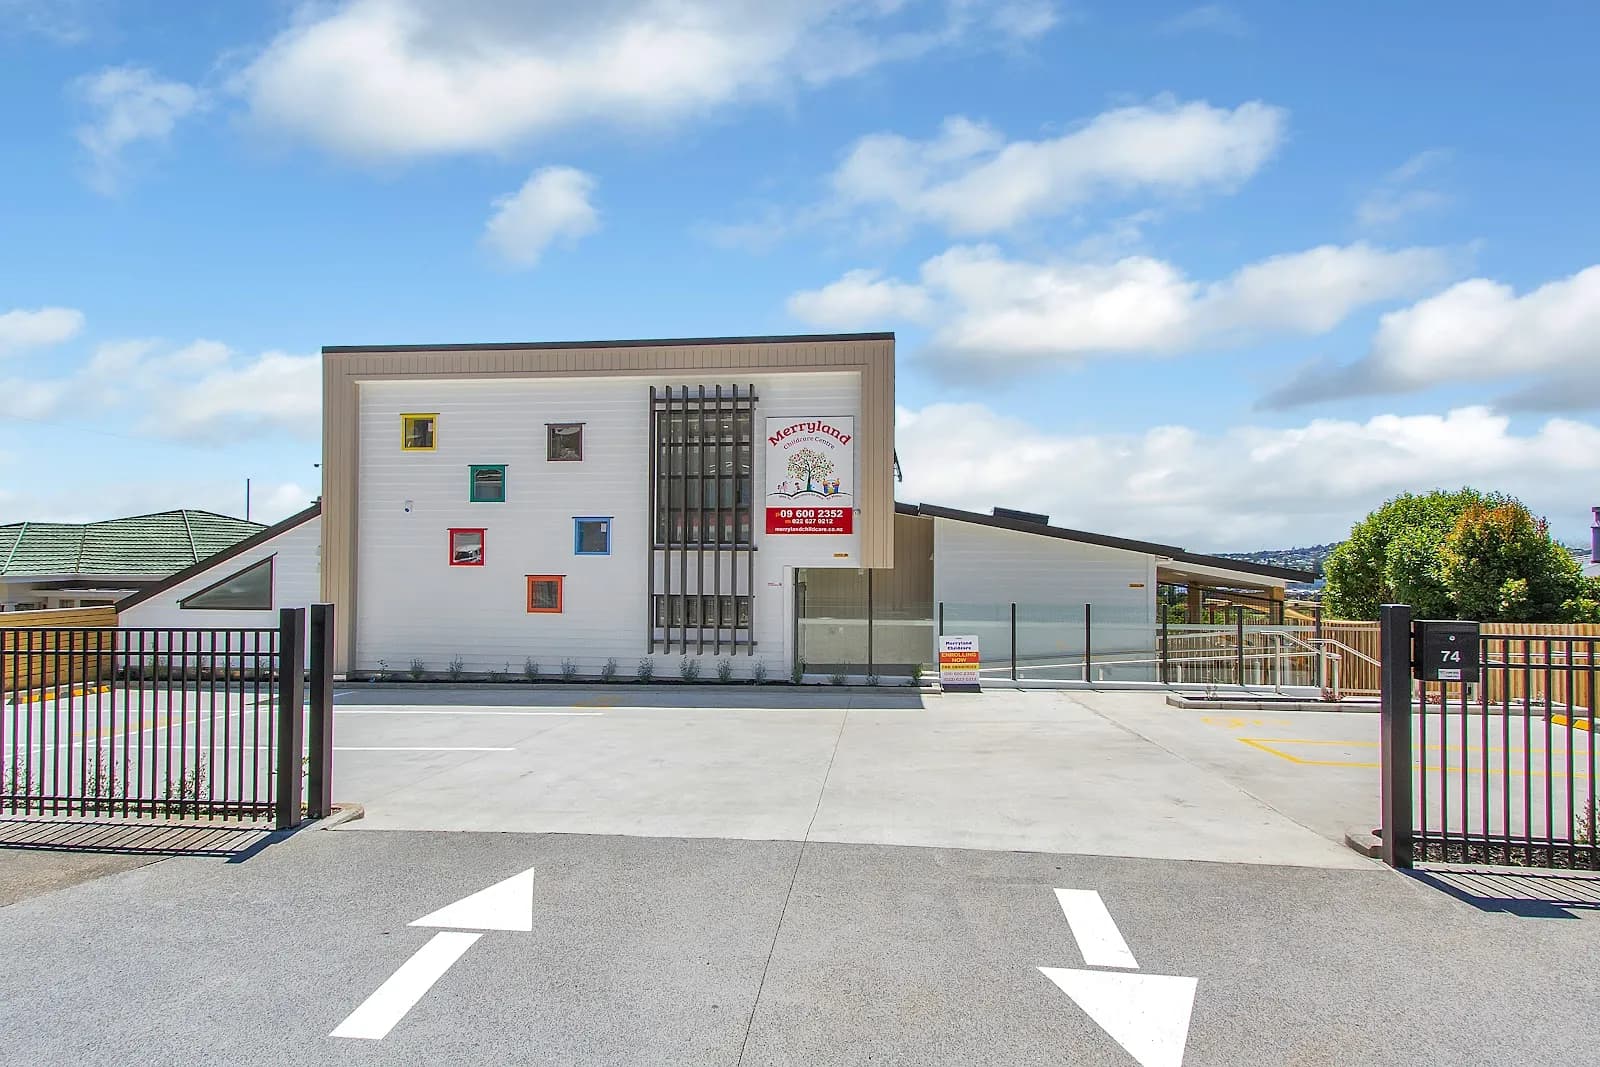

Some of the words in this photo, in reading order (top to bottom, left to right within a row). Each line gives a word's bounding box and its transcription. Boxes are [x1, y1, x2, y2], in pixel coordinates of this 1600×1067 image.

[768, 421, 852, 447] Merryland
[814, 436, 836, 450] Centre
[780, 509, 793, 518] 09
[795, 509, 815, 518] 600
[817, 509, 843, 518] 2352
[1440, 650, 1460, 662] 74
